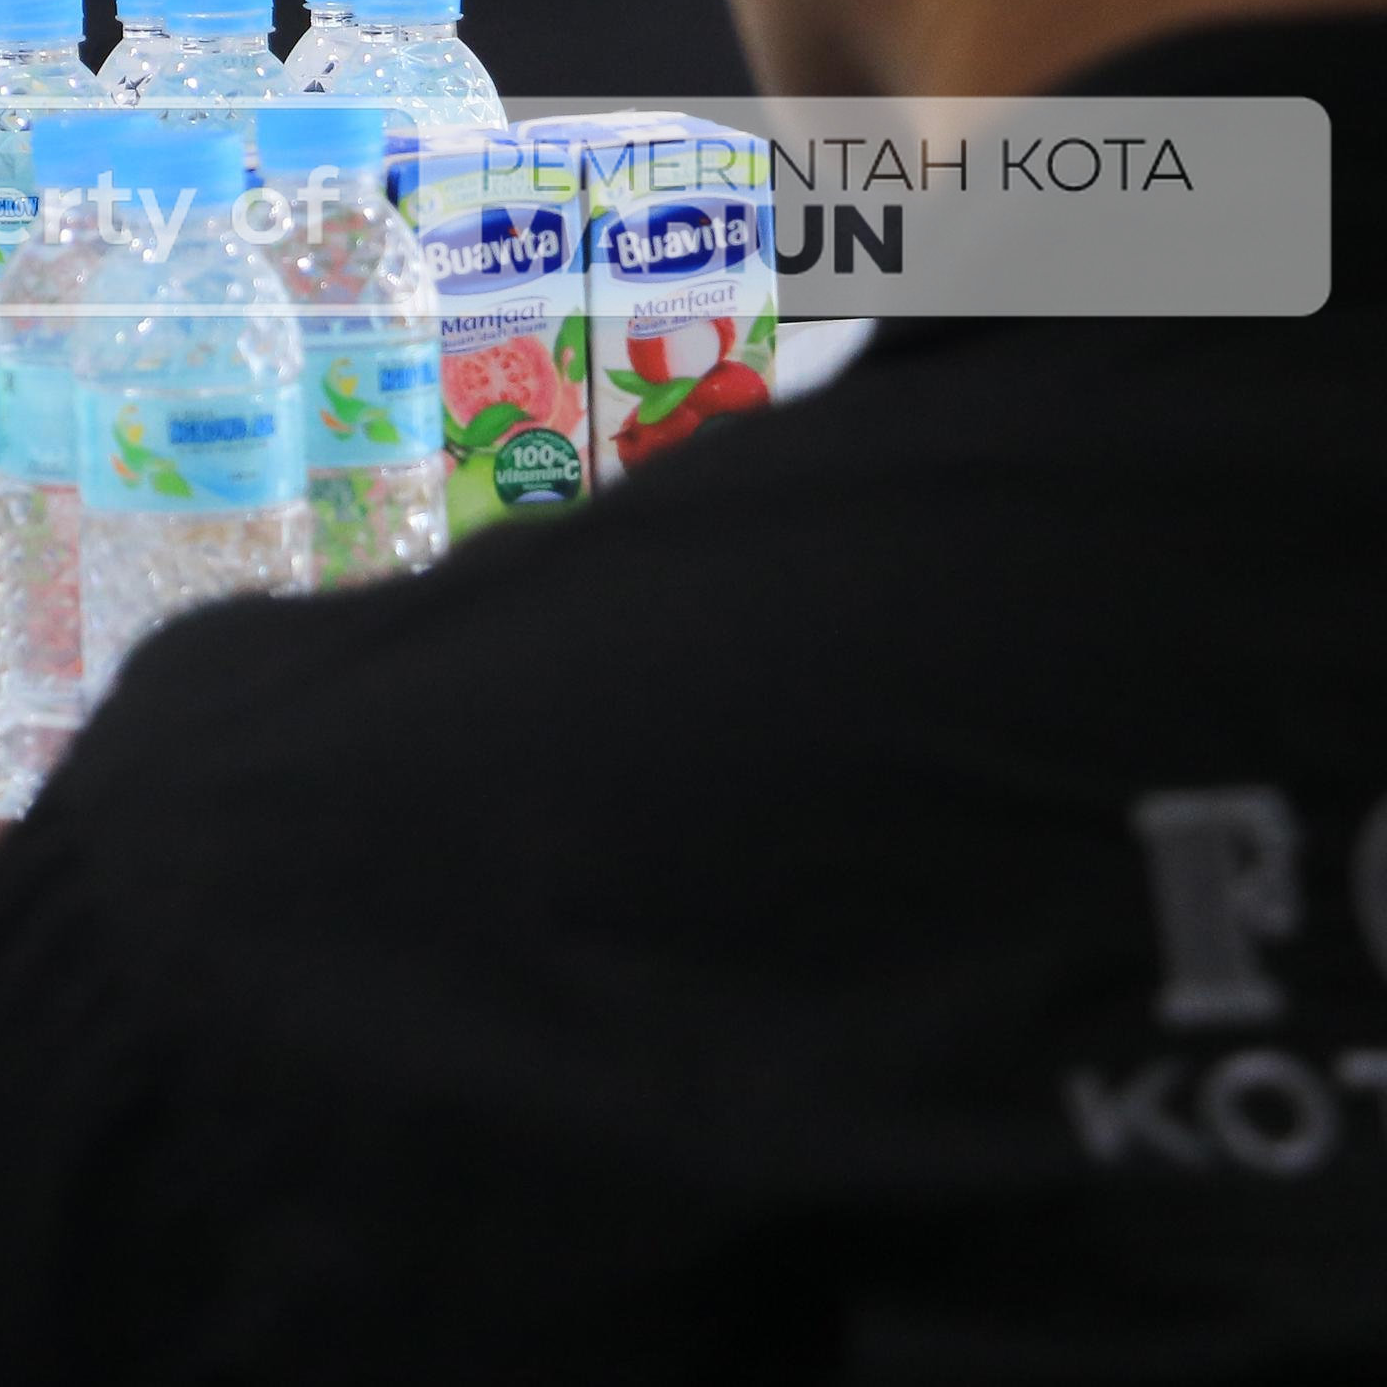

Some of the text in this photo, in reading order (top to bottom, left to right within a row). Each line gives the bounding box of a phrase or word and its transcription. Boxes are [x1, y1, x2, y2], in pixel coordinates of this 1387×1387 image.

[424, 225, 560, 282] Buavita
[616, 216, 750, 270] Buavita
[440, 302, 546, 337] Manfaat
[632, 285, 737, 319] Manfaat
